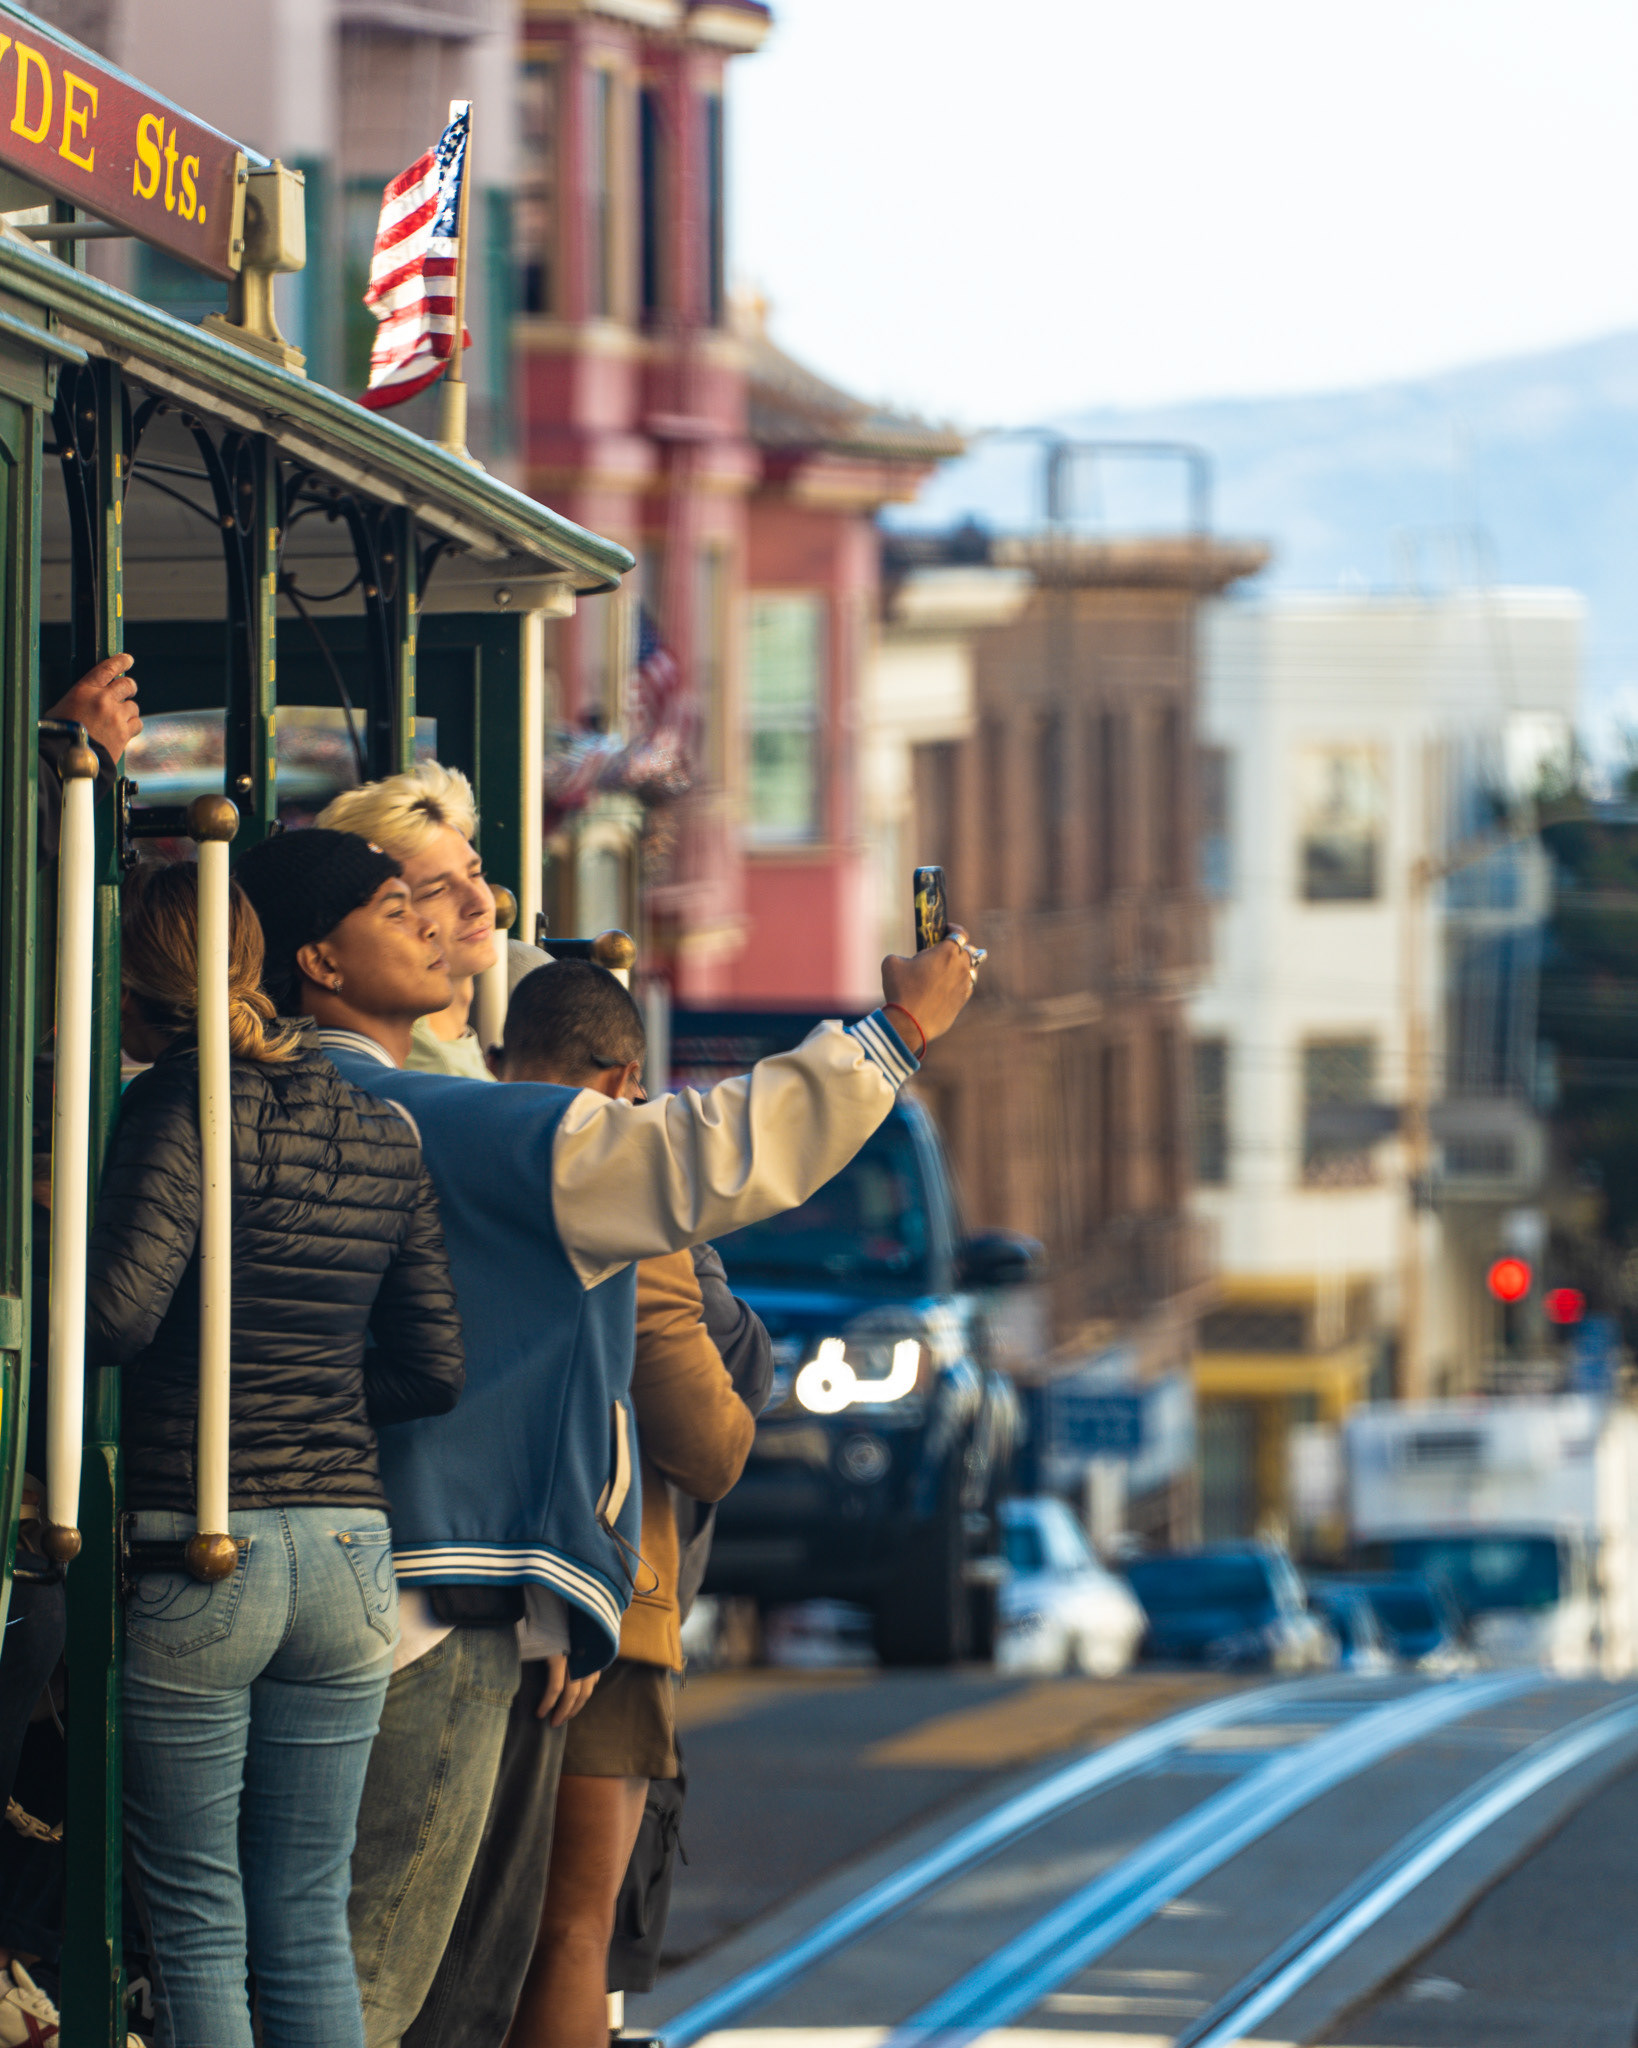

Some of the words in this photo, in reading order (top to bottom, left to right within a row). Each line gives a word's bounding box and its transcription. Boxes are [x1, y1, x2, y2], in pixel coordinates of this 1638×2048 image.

[0, 33, 98, 173] DE
[133, 113, 206, 224] Sts.
[115, 453, 123, 618] HOLD
[268, 527, 277, 682] HOLD
